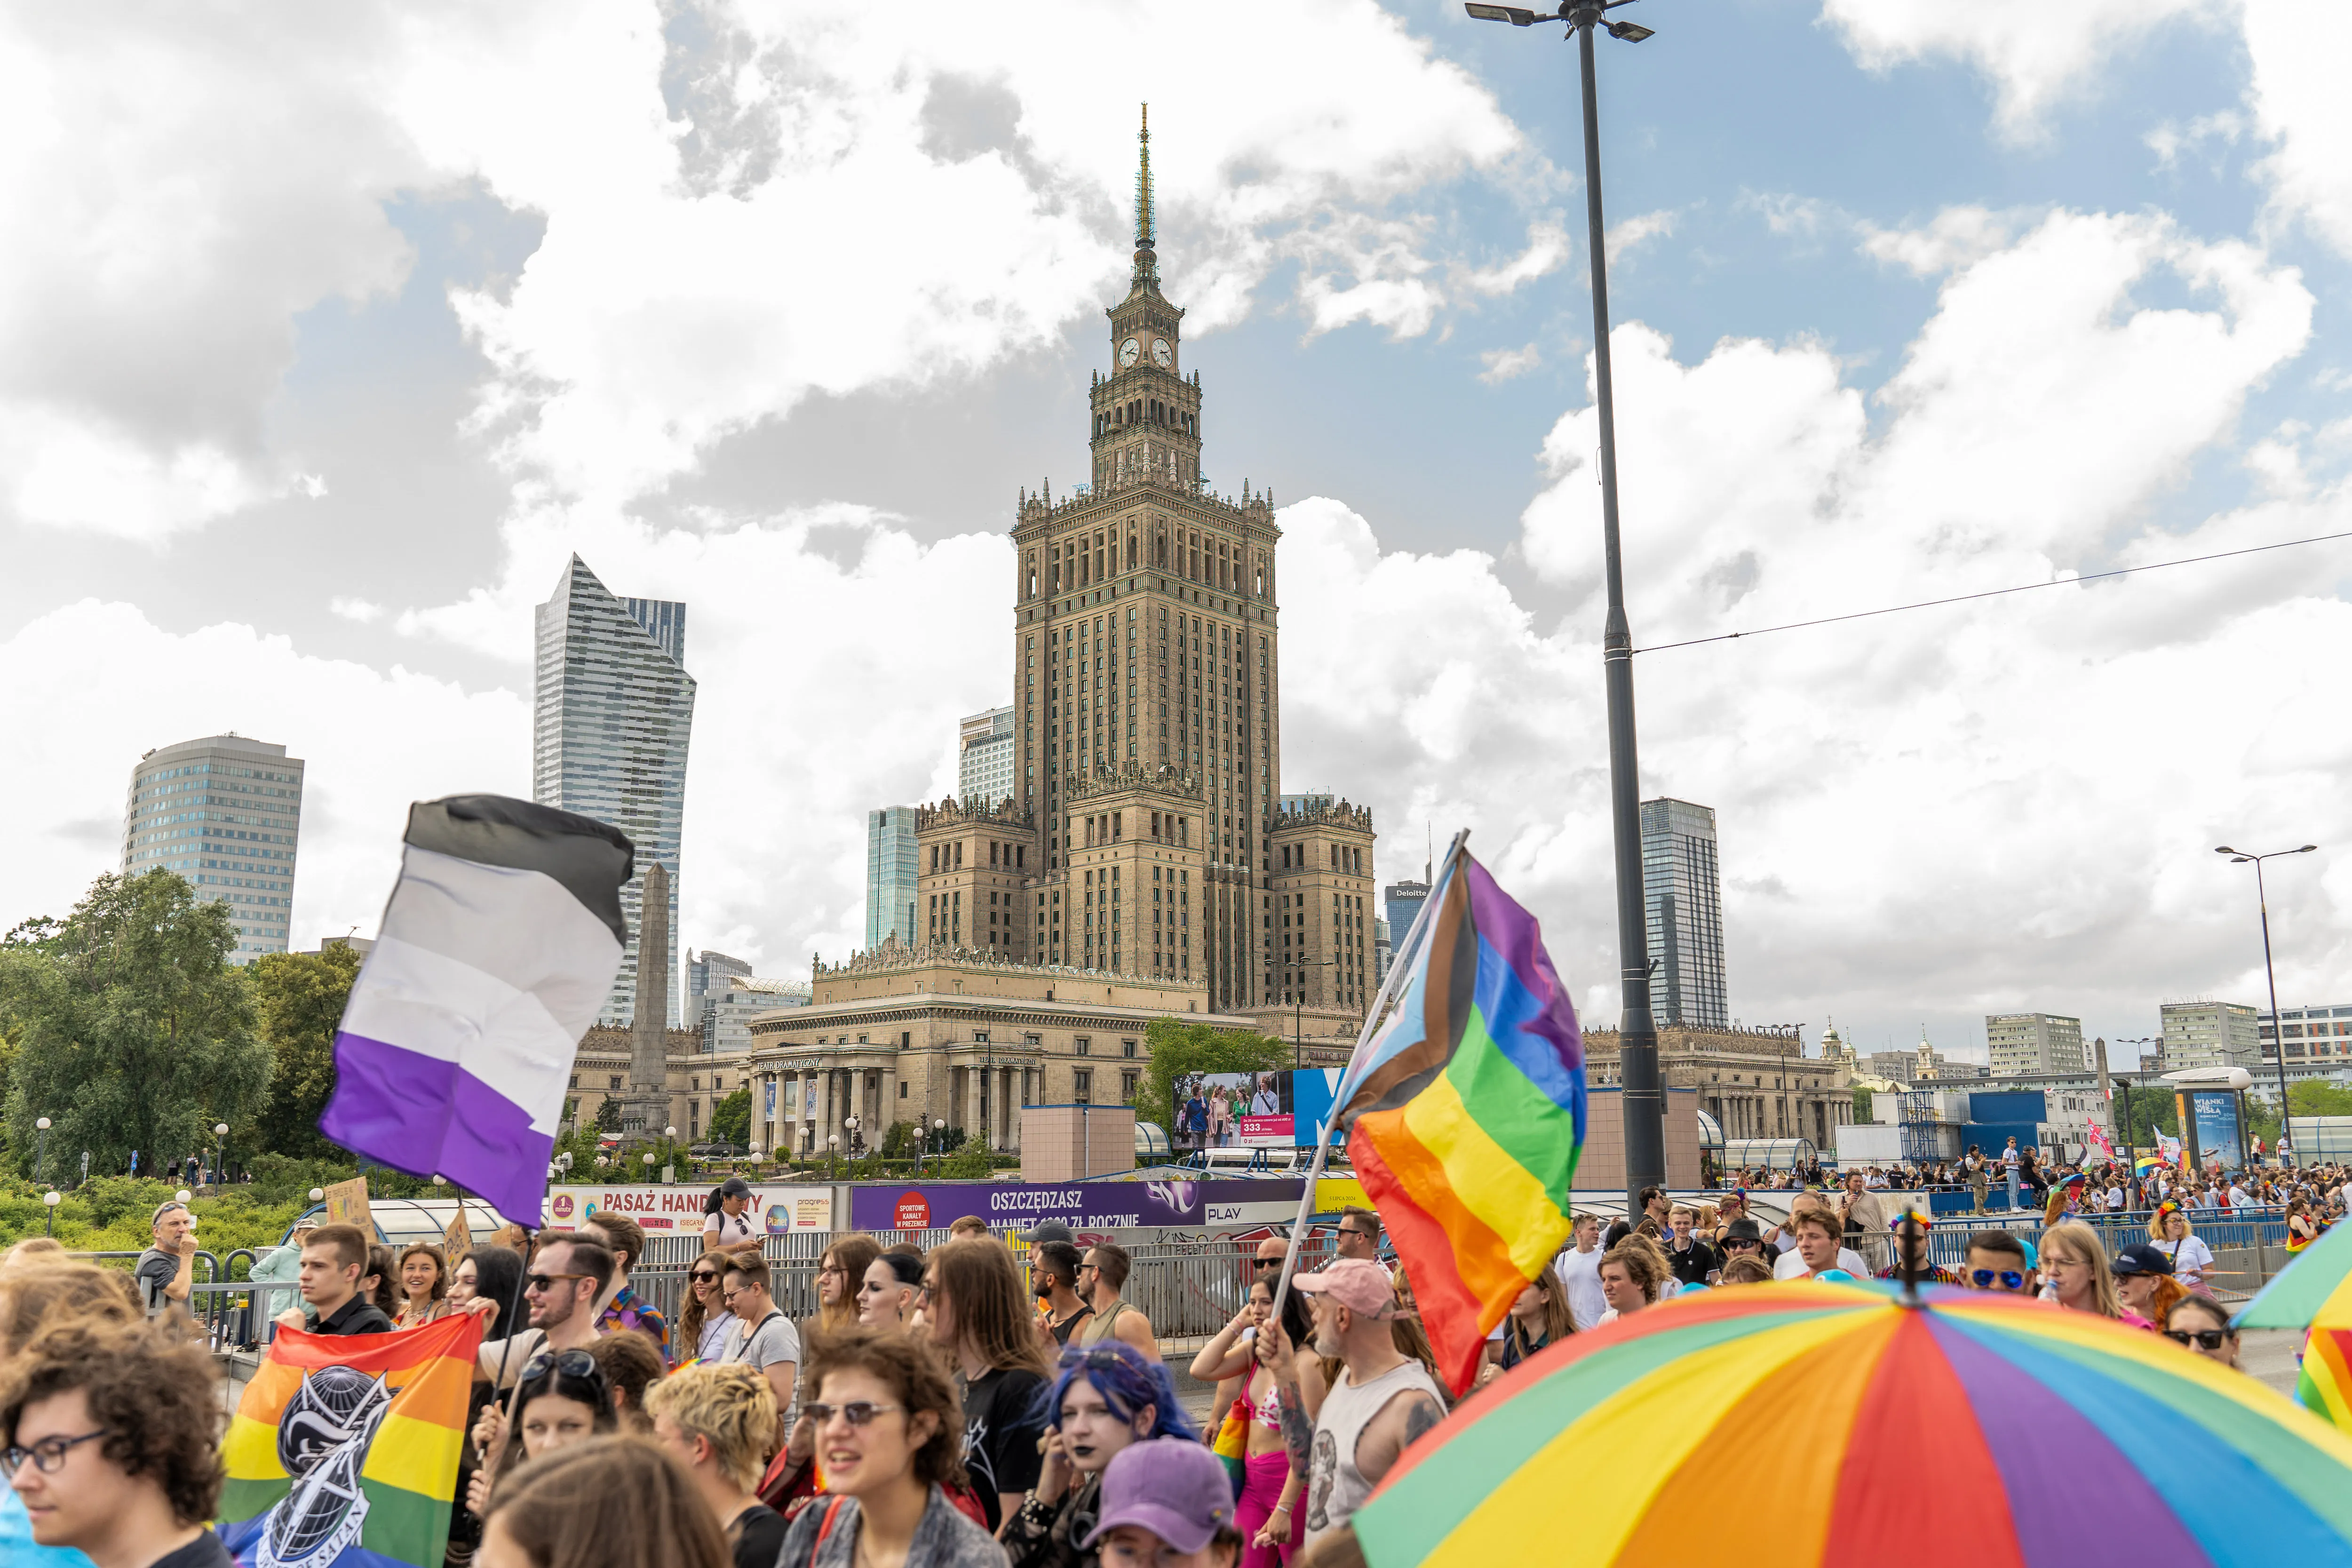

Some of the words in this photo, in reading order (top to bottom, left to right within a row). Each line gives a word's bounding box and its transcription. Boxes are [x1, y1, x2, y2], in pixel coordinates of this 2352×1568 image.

[757, 1062, 774, 1070] TEATR
[776, 1058, 819, 1069] DRAMATYCZNY
[1244, 1123, 1261, 1132] 333
[560, 1196, 565, 1206] 1
[604, 1189, 656, 1212] PASAŻ
[662, 1193, 763, 1213] HANDY
[991, 1190, 1082, 1214] OSZCZĘDZASZ
[1208, 1208, 1241, 1220] PLAY
[767, 1216, 787, 1226] Planet
[1071, 1216, 1083, 1227] ZŁ
[1089, 1214, 1139, 1227] ROCZNIE
[318, 1503, 363, 1567] SATAN
